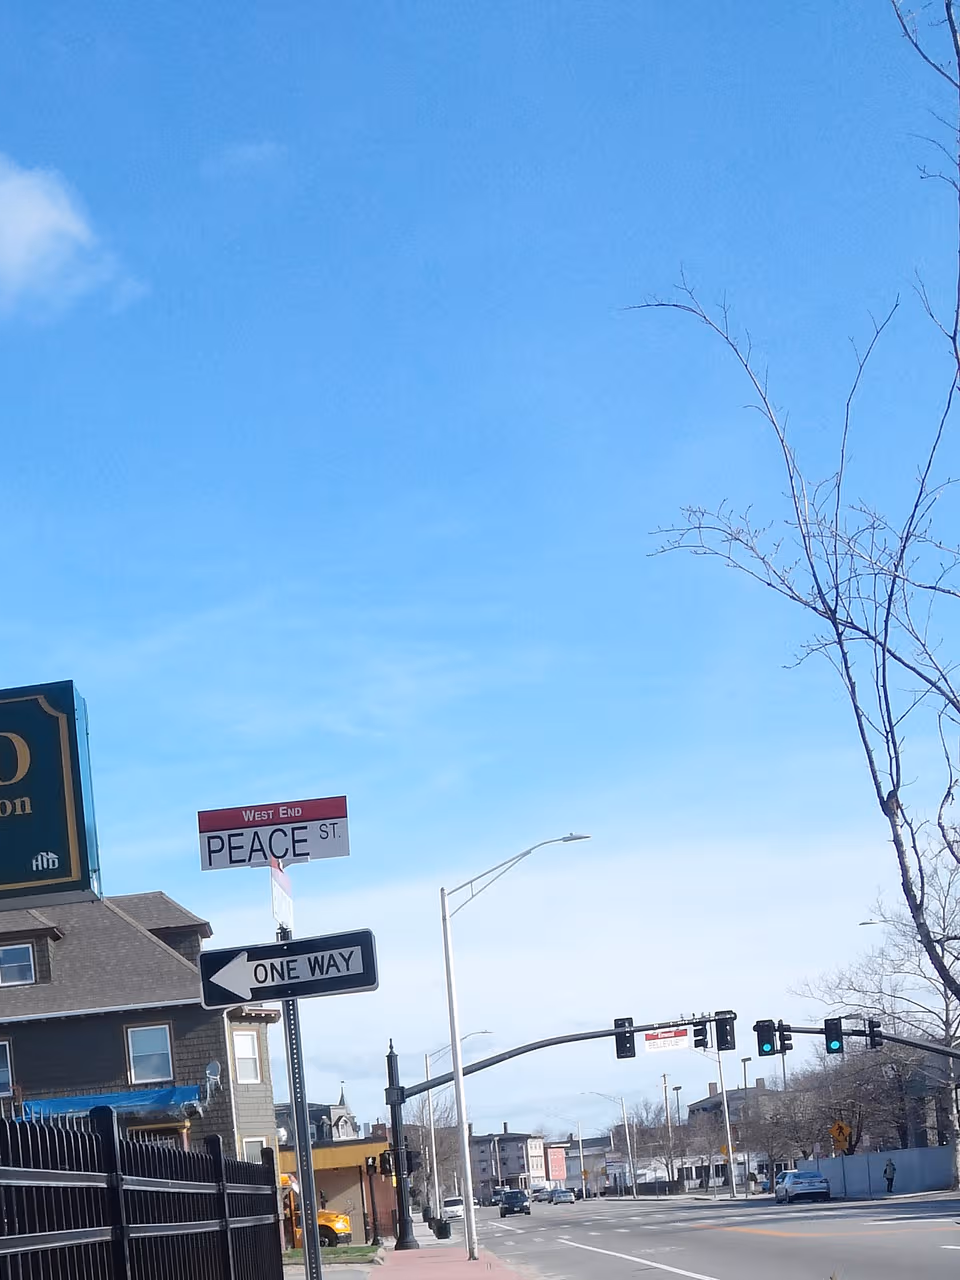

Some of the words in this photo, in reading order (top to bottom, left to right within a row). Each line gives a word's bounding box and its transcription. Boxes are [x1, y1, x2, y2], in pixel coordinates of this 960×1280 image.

[207, 825, 310, 866] PEACE
[254, 959, 300, 984] ONE
[307, 950, 355, 977] WAY
